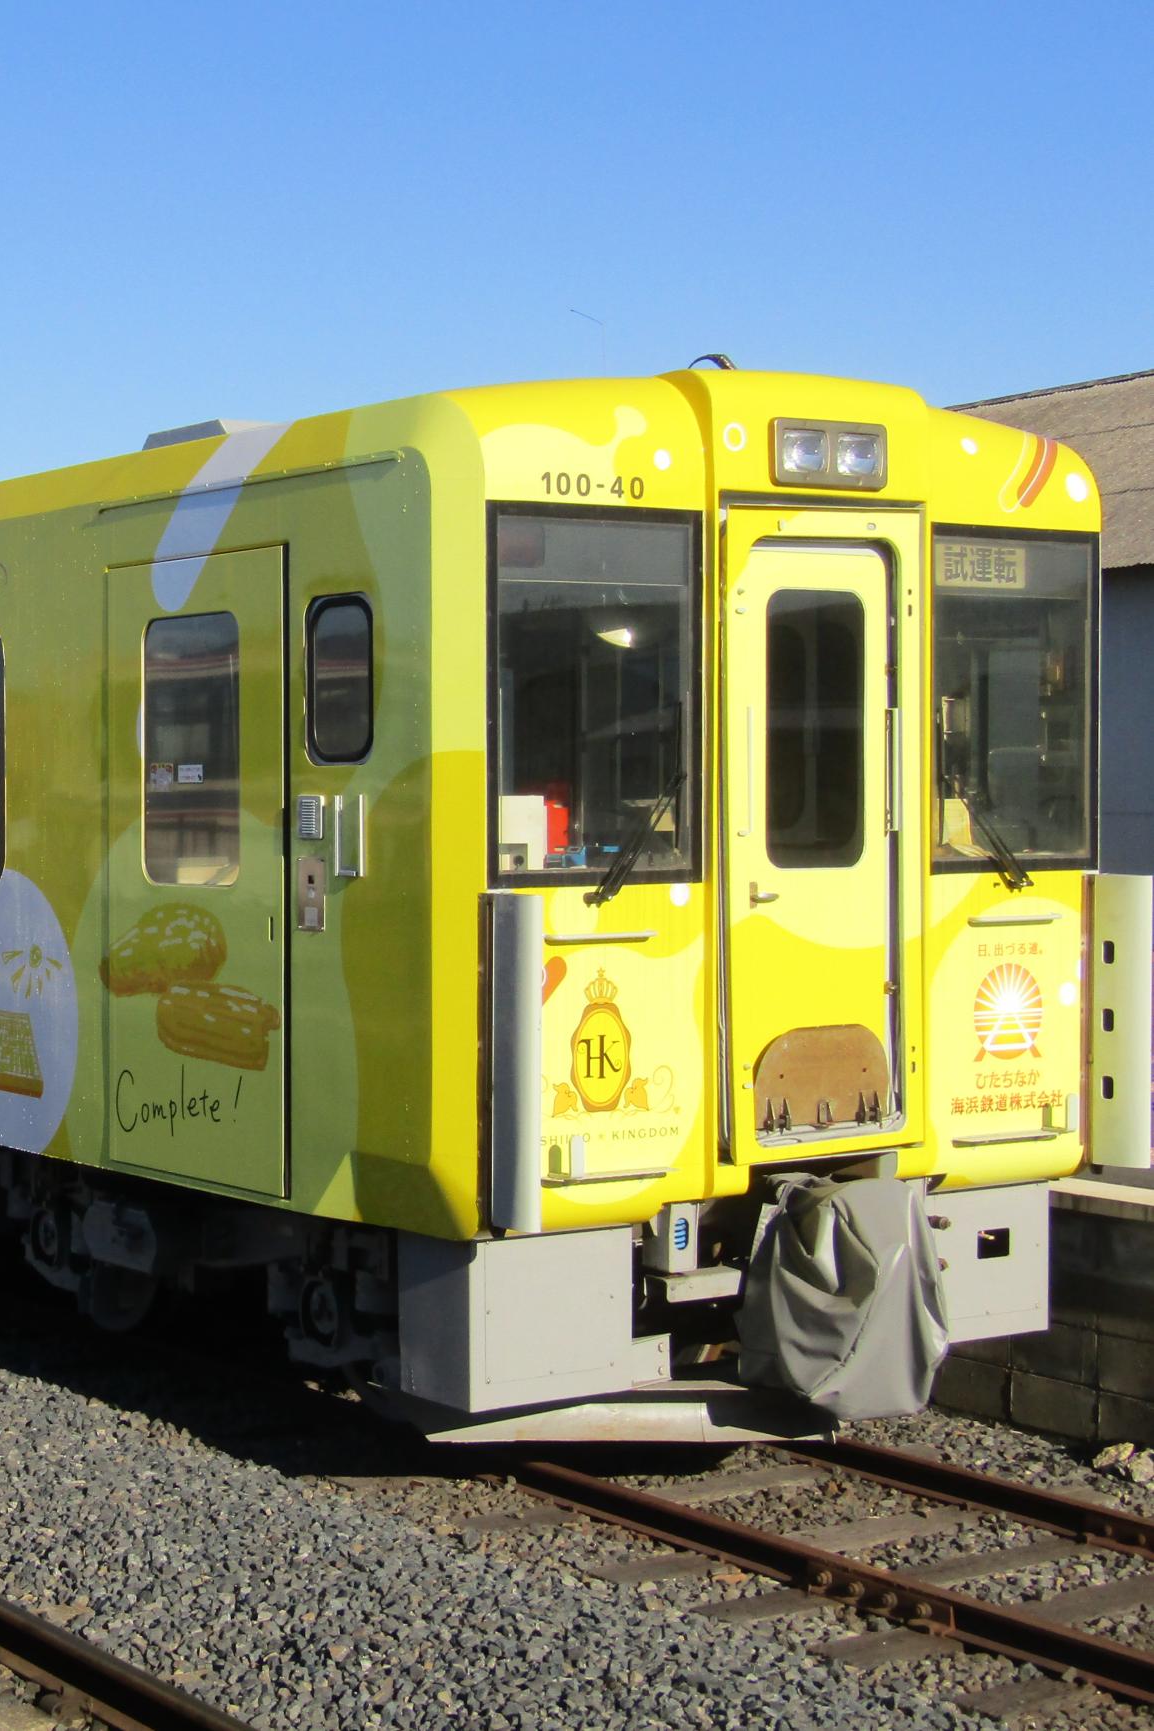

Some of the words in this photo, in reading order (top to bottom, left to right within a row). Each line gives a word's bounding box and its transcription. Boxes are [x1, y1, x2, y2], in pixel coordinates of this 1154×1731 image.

[540, 471, 645, 500] 100-40
[943, 544, 1018, 583] 試運転
[975, 1068, 1041, 1090] ひたちなか
[950, 1089, 1064, 1116] 海浜鉄道株式会社
[611, 1126, 680, 1142] KINGDOM
